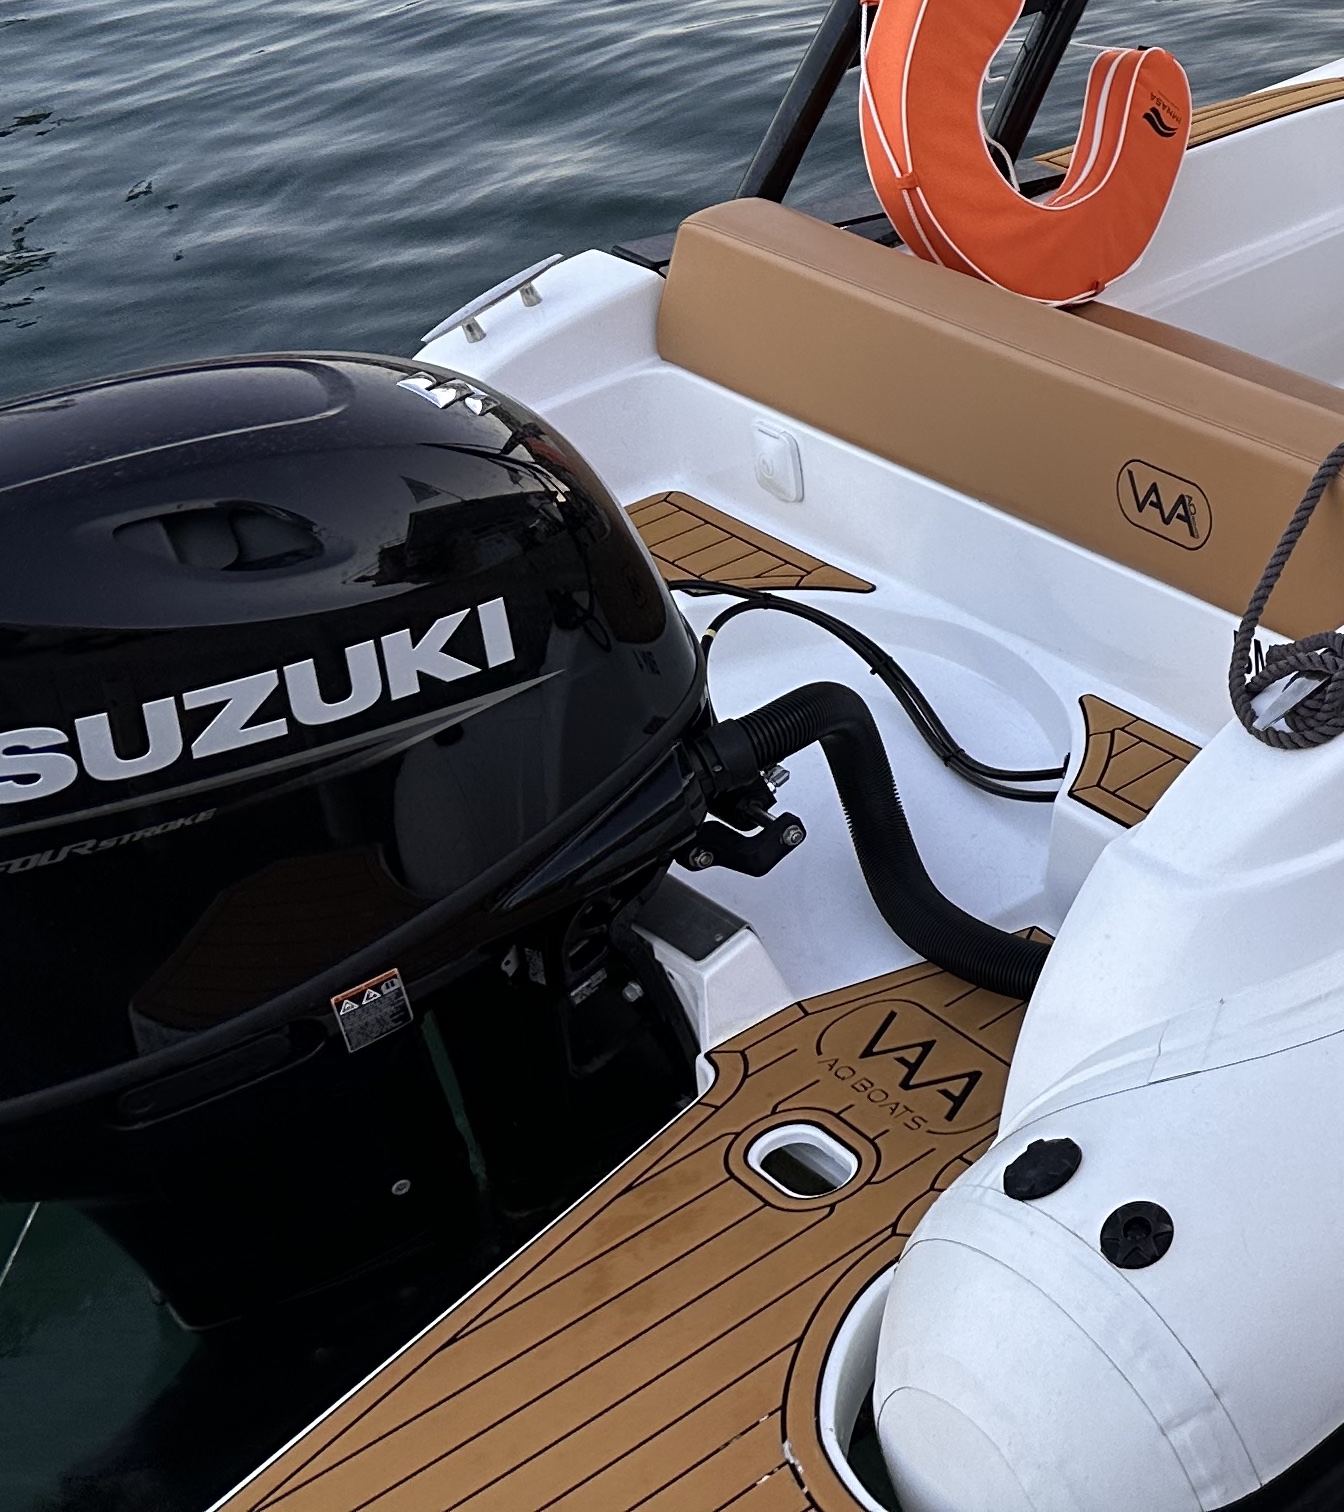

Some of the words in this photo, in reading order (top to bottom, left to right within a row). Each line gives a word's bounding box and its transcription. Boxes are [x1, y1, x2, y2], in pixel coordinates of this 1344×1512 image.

[1127, 468, 1196, 539] VAA
[0, 597, 515, 804] SUZUKI
[859, 1010, 983, 1122] VAA
